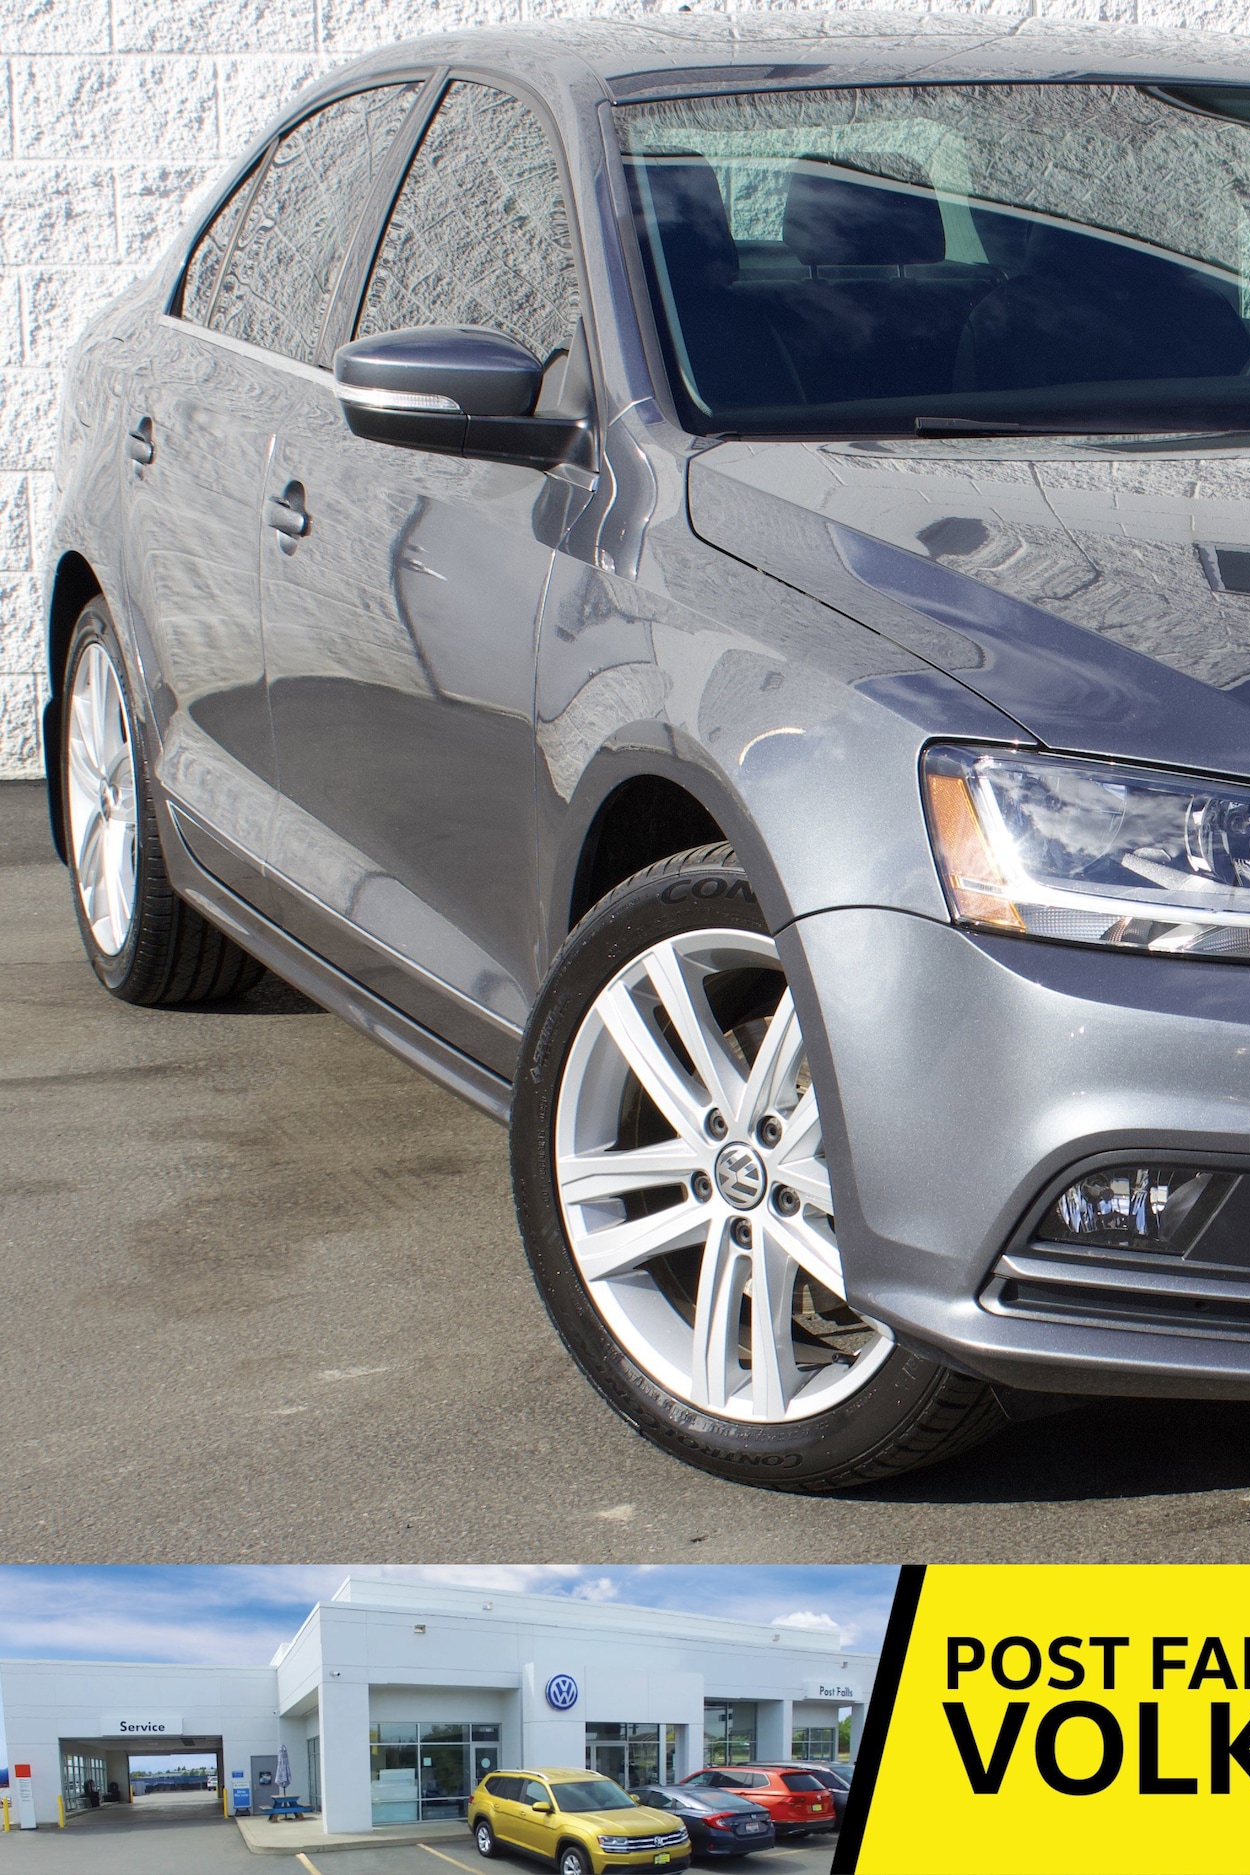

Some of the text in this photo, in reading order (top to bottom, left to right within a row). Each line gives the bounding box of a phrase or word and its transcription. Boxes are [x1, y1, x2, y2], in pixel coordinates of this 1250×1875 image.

[819, 1685, 853, 1697] Post Falls
[120, 1721, 165, 1732] Service
